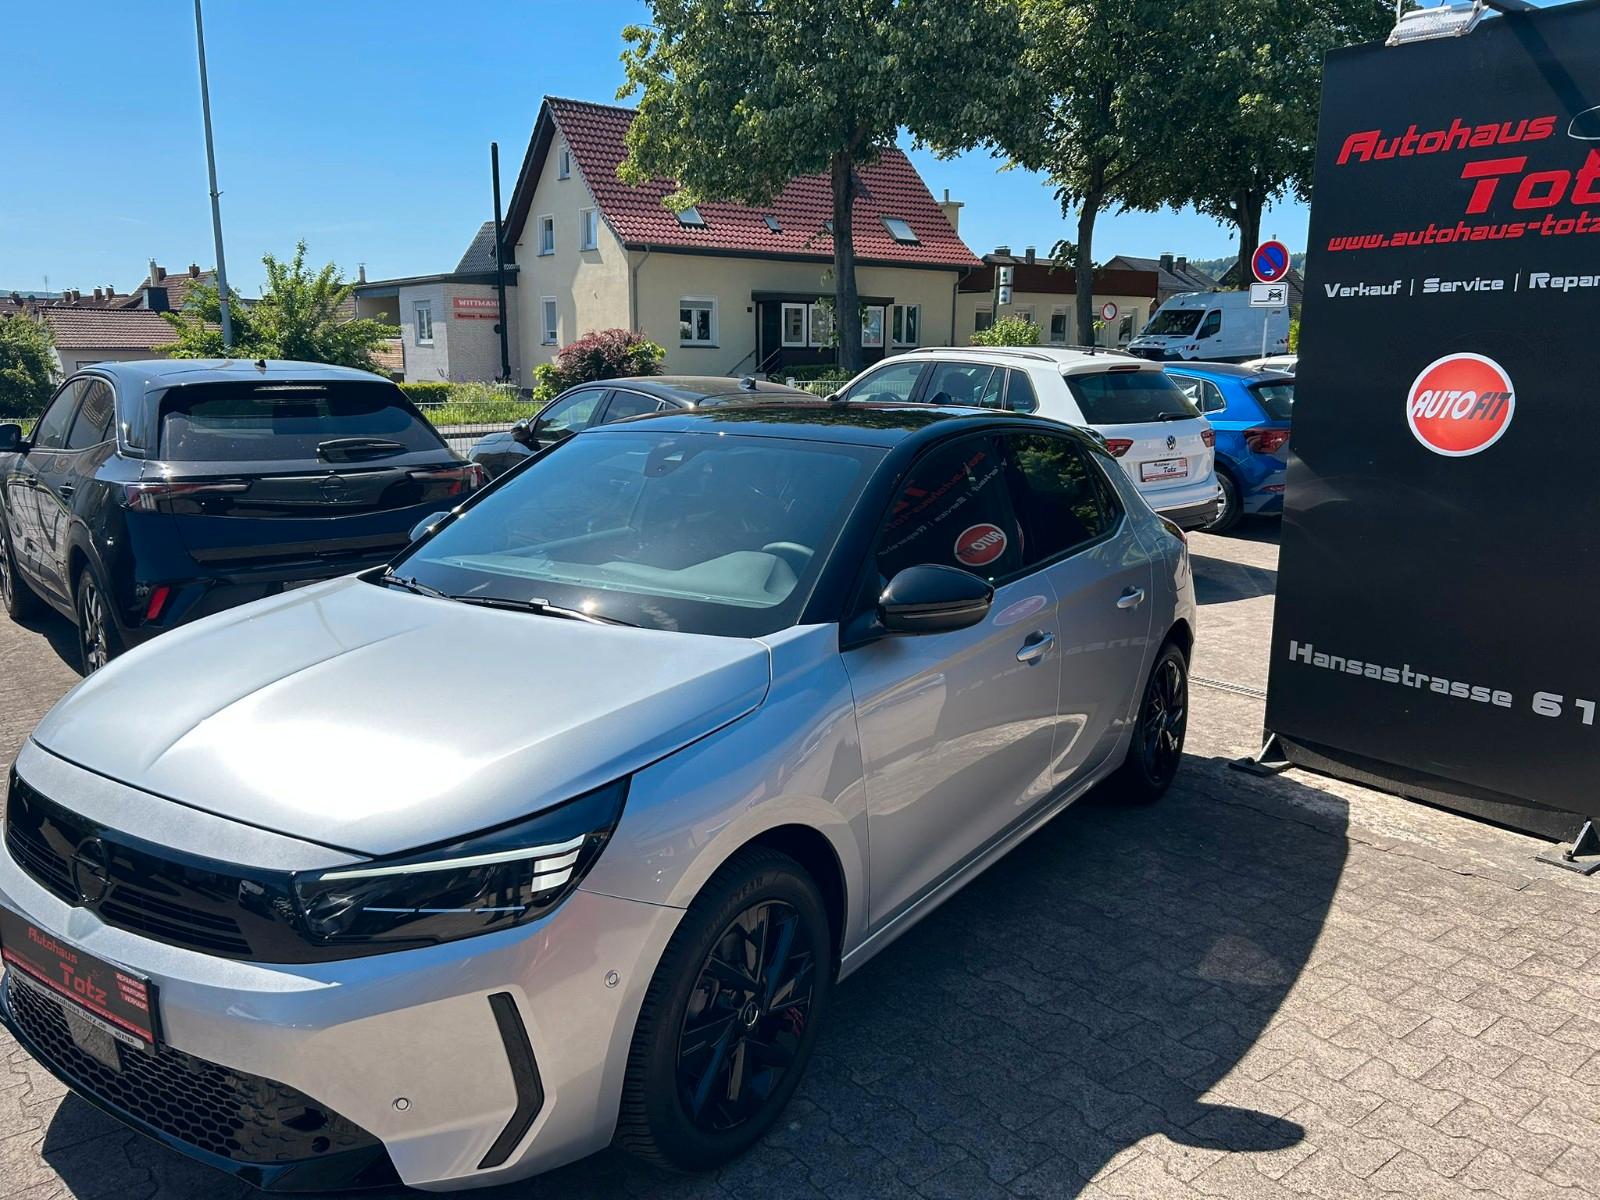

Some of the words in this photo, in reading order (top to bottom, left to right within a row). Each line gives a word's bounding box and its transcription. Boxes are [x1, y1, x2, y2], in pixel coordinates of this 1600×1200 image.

[1336, 115, 1557, 165] Autohaus
[1324, 280, 1402, 298] Verkauf
[1422, 277, 1504, 294] Service
[1412, 389, 1513, 420] AUTOFIT
[1288, 640, 1513, 708] Hansastrasse
[28, 926, 79, 964] Autohaus
[59, 961, 109, 1006] Totz
